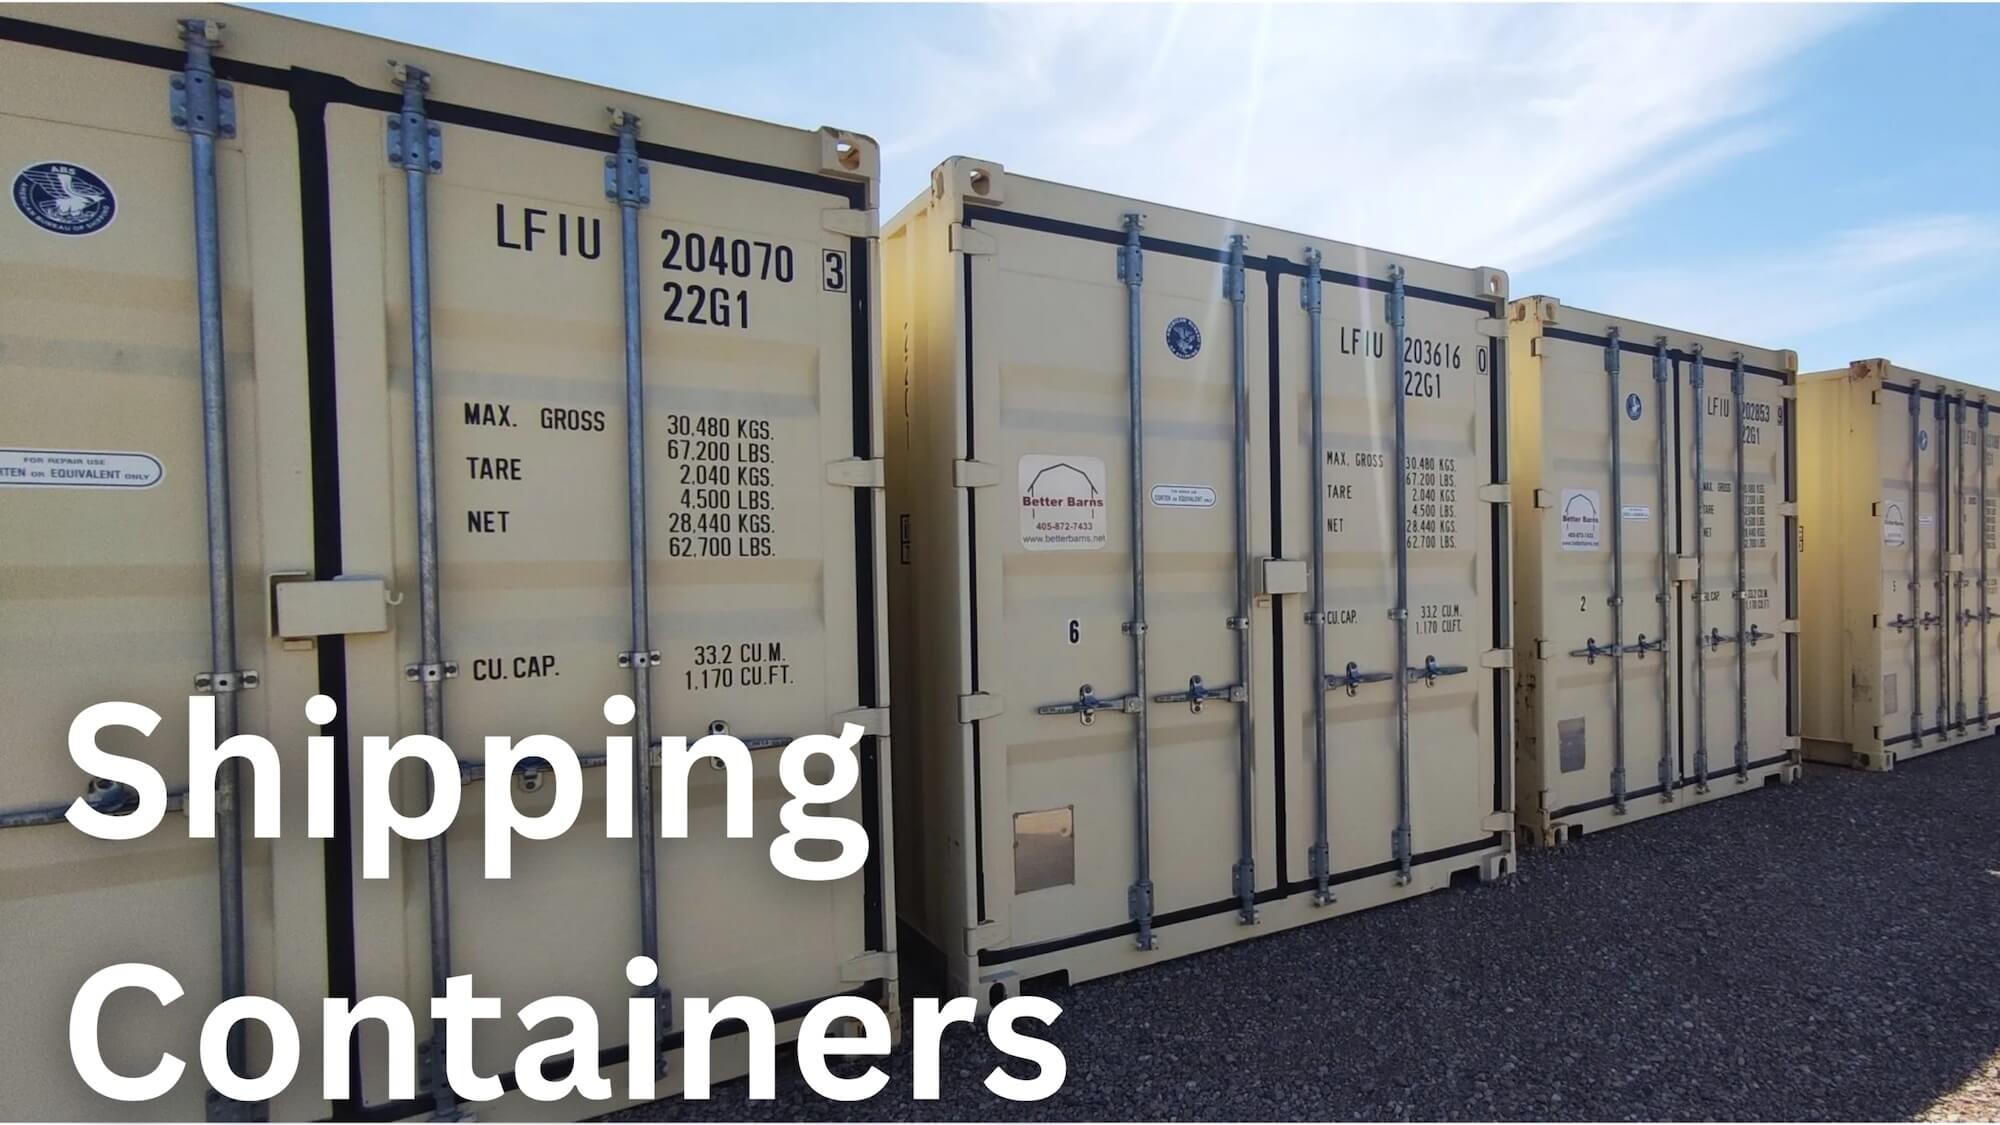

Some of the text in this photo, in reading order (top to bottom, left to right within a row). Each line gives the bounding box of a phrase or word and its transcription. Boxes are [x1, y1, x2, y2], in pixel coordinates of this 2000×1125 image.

[51, 166, 76, 175] ABS
[496, 203, 844, 290] LFIU 204070 3
[663, 281, 749, 329] 22G1
[1341, 327, 1486, 372] LFIU 203616 0
[1404, 370, 1440, 399] 22G1
[464, 403, 605, 432] MAX. GROSS
[1707, 396, 1729, 418] LFIU
[737, 419, 775, 440] KGS.
[737, 443, 775, 464] LBS.
[1326, 451, 1384, 468] MAX. GROSS
[51, 468, 121, 480] EQUIVALENT
[124, 473, 149, 481] ONLY
[466, 457, 522, 481] TARE
[737, 466, 775, 487] KGS.
[737, 490, 775, 510] LBS.
[1022, 496, 1104, 507] Better Barns
[1327, 485, 1352, 499] TARE
[467, 511, 510, 533] NET
[738, 513, 776, 534] KGS.
[1036, 522, 1093, 531] 405-872-7433
[1327, 518, 1343, 532] NET
[739, 537, 776, 557] LBS.
[1022, 535, 1105, 543] www.betterbarns.net
[1580, 595, 1586, 611] 2
[1070, 620, 1079, 643] 6
[694, 645, 733, 666] 33.2
